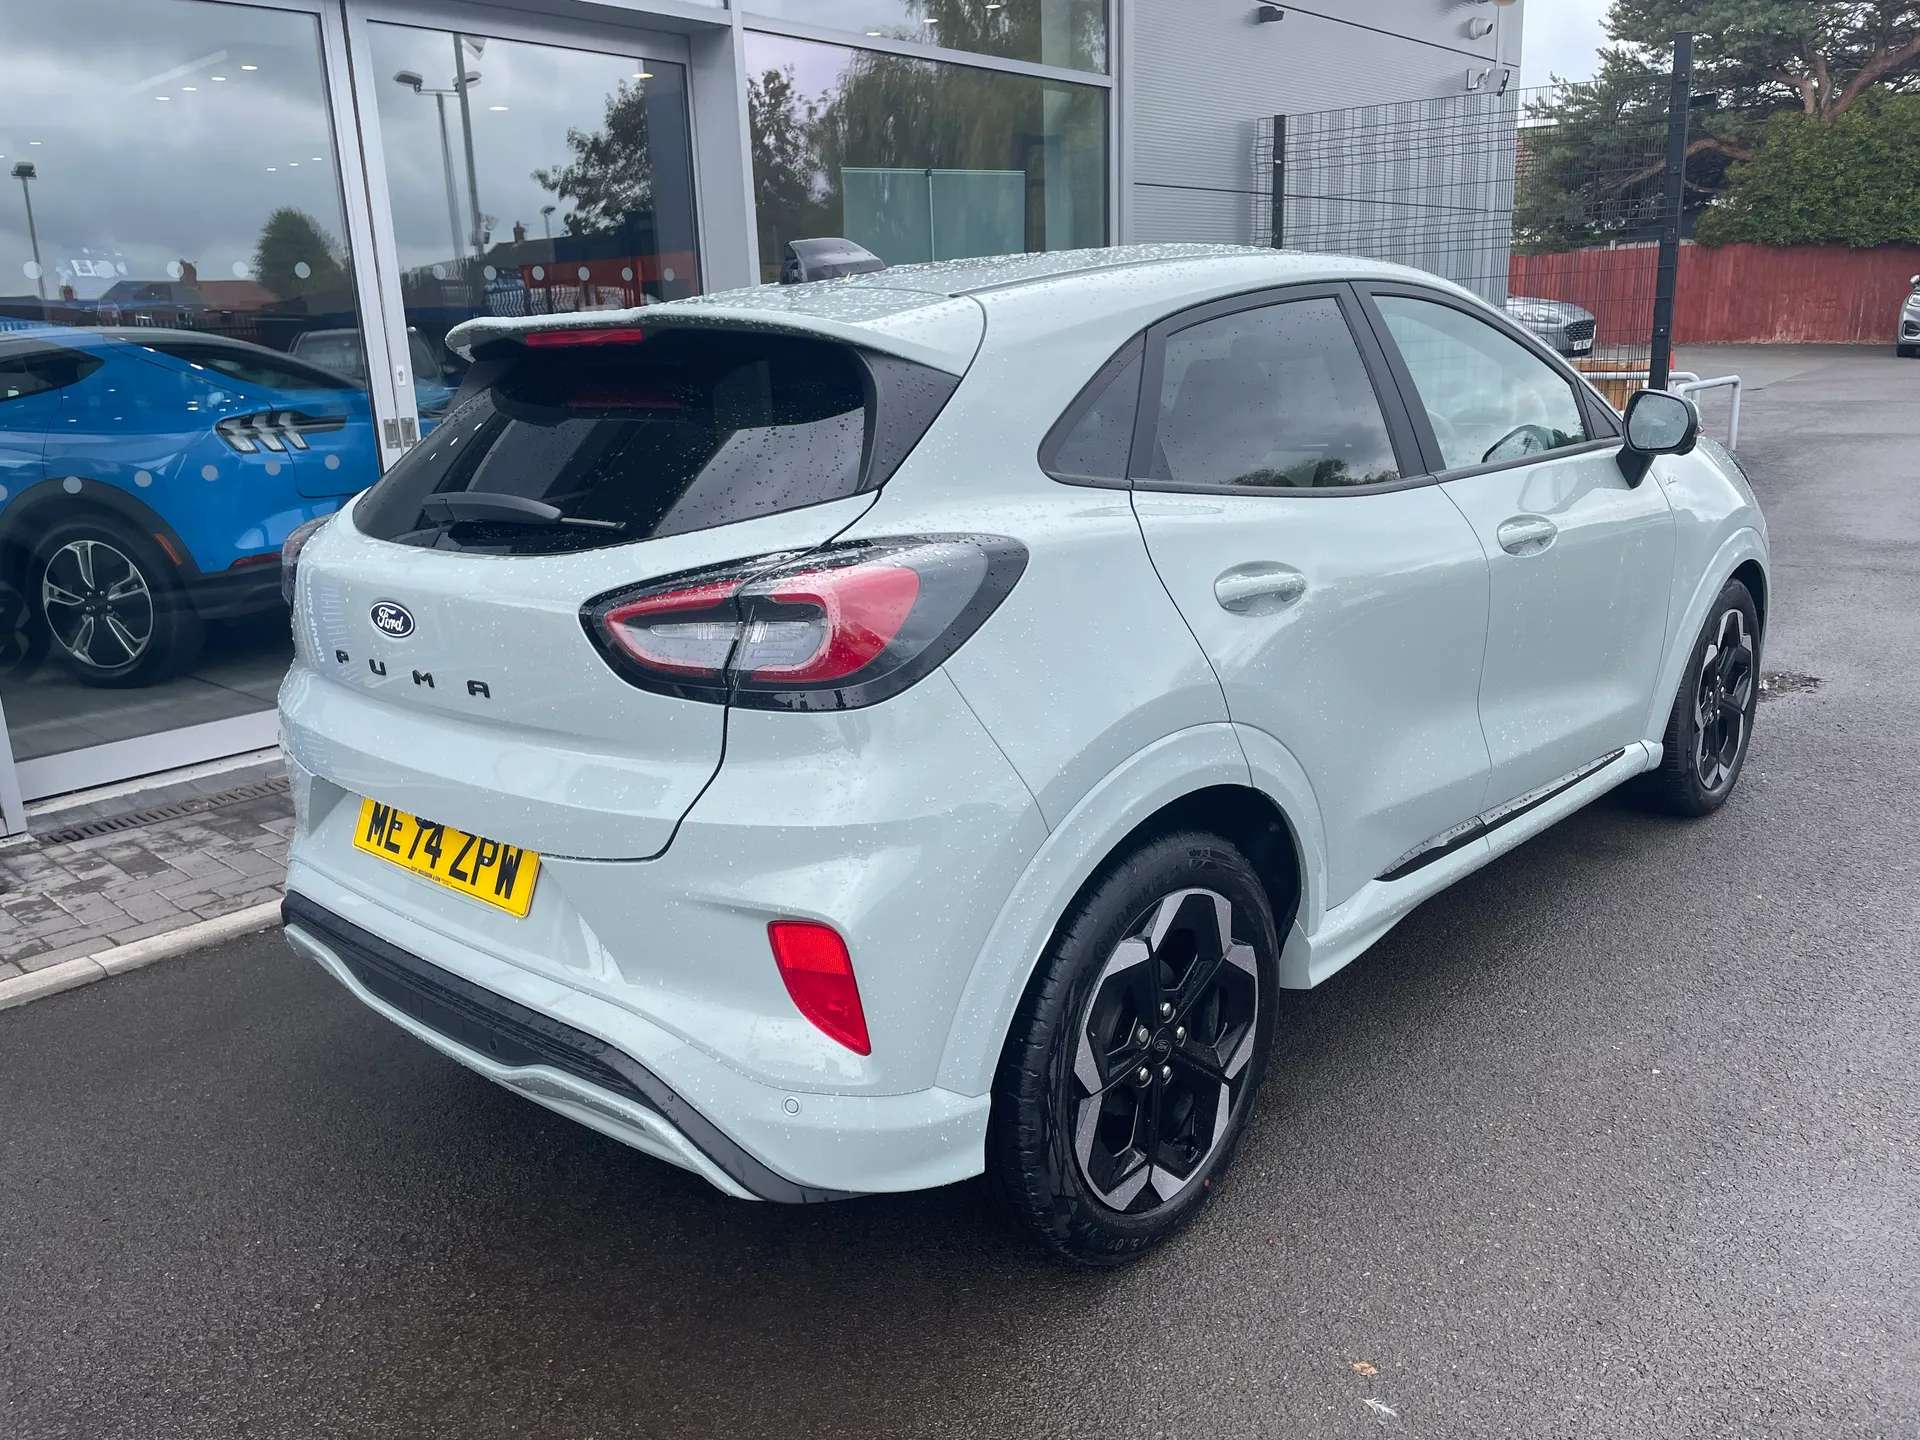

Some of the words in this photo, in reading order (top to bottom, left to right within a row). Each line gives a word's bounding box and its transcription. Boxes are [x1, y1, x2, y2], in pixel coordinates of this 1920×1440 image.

[377, 606, 404, 632] Ford
[335, 649, 490, 698] PUMA
[448, 831, 523, 900] ZPW
